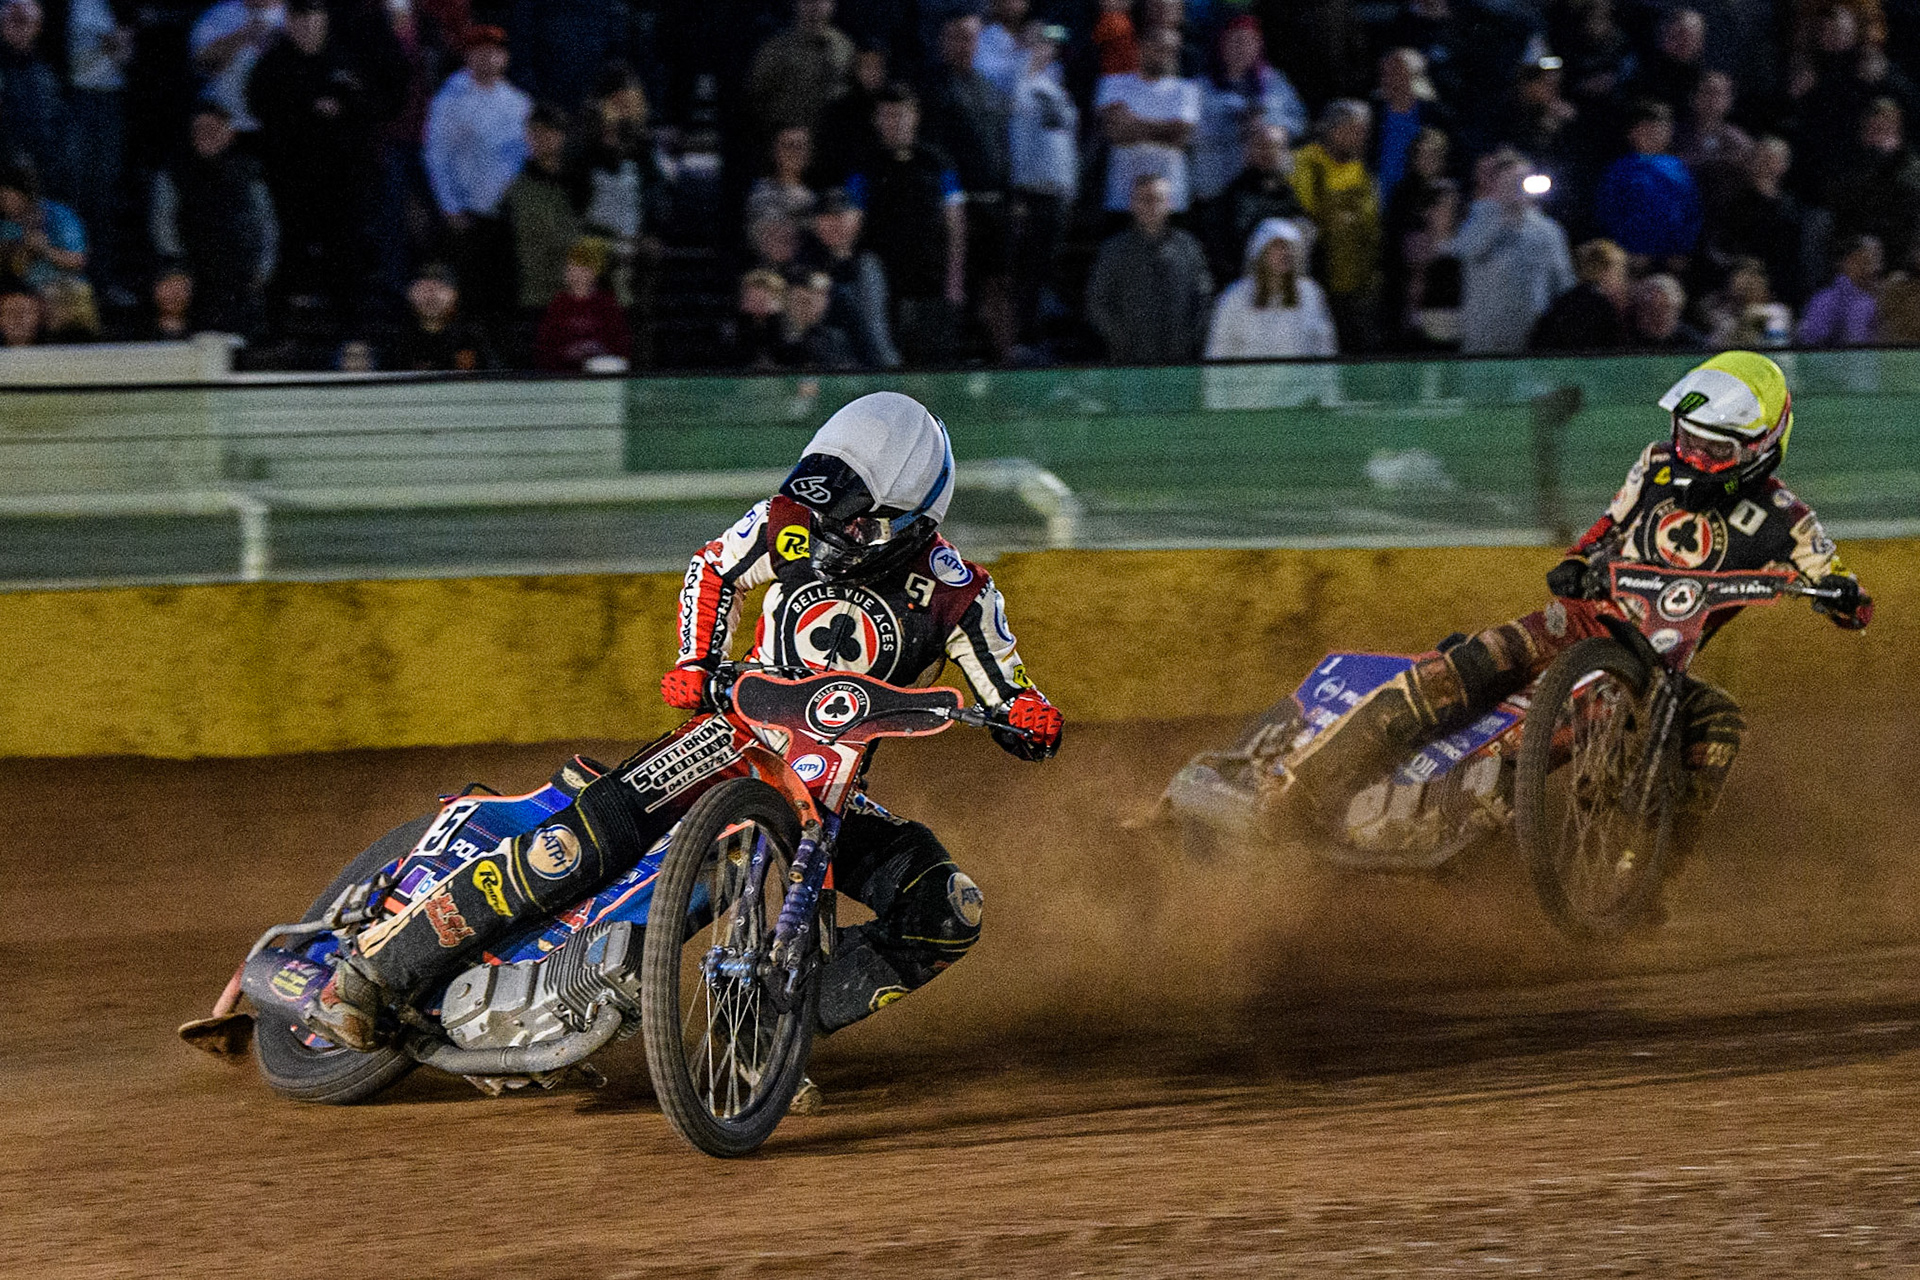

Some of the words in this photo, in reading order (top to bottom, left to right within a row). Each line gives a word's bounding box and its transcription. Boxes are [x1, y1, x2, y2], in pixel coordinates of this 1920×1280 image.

[937, 553, 966, 576] ATPI
[908, 576, 930, 604] 5
[791, 587, 836, 614] BELLE
[845, 588, 875, 611] VUE
[873, 613, 895, 652] ACES
[813, 685, 836, 703] BELLE
[838, 684, 854, 692] VUE
[853, 688, 867, 706] ACES
[632, 748, 683, 792] SCOTT
[657, 736, 728, 785] FLOORING
[668, 772, 695, 793] 0412
[695, 758, 716, 775] 637
[795, 763, 819, 772] ATPI
[423, 804, 474, 852] 5
[447, 838, 481, 861] POL
[542, 835, 567, 867] ATPI
